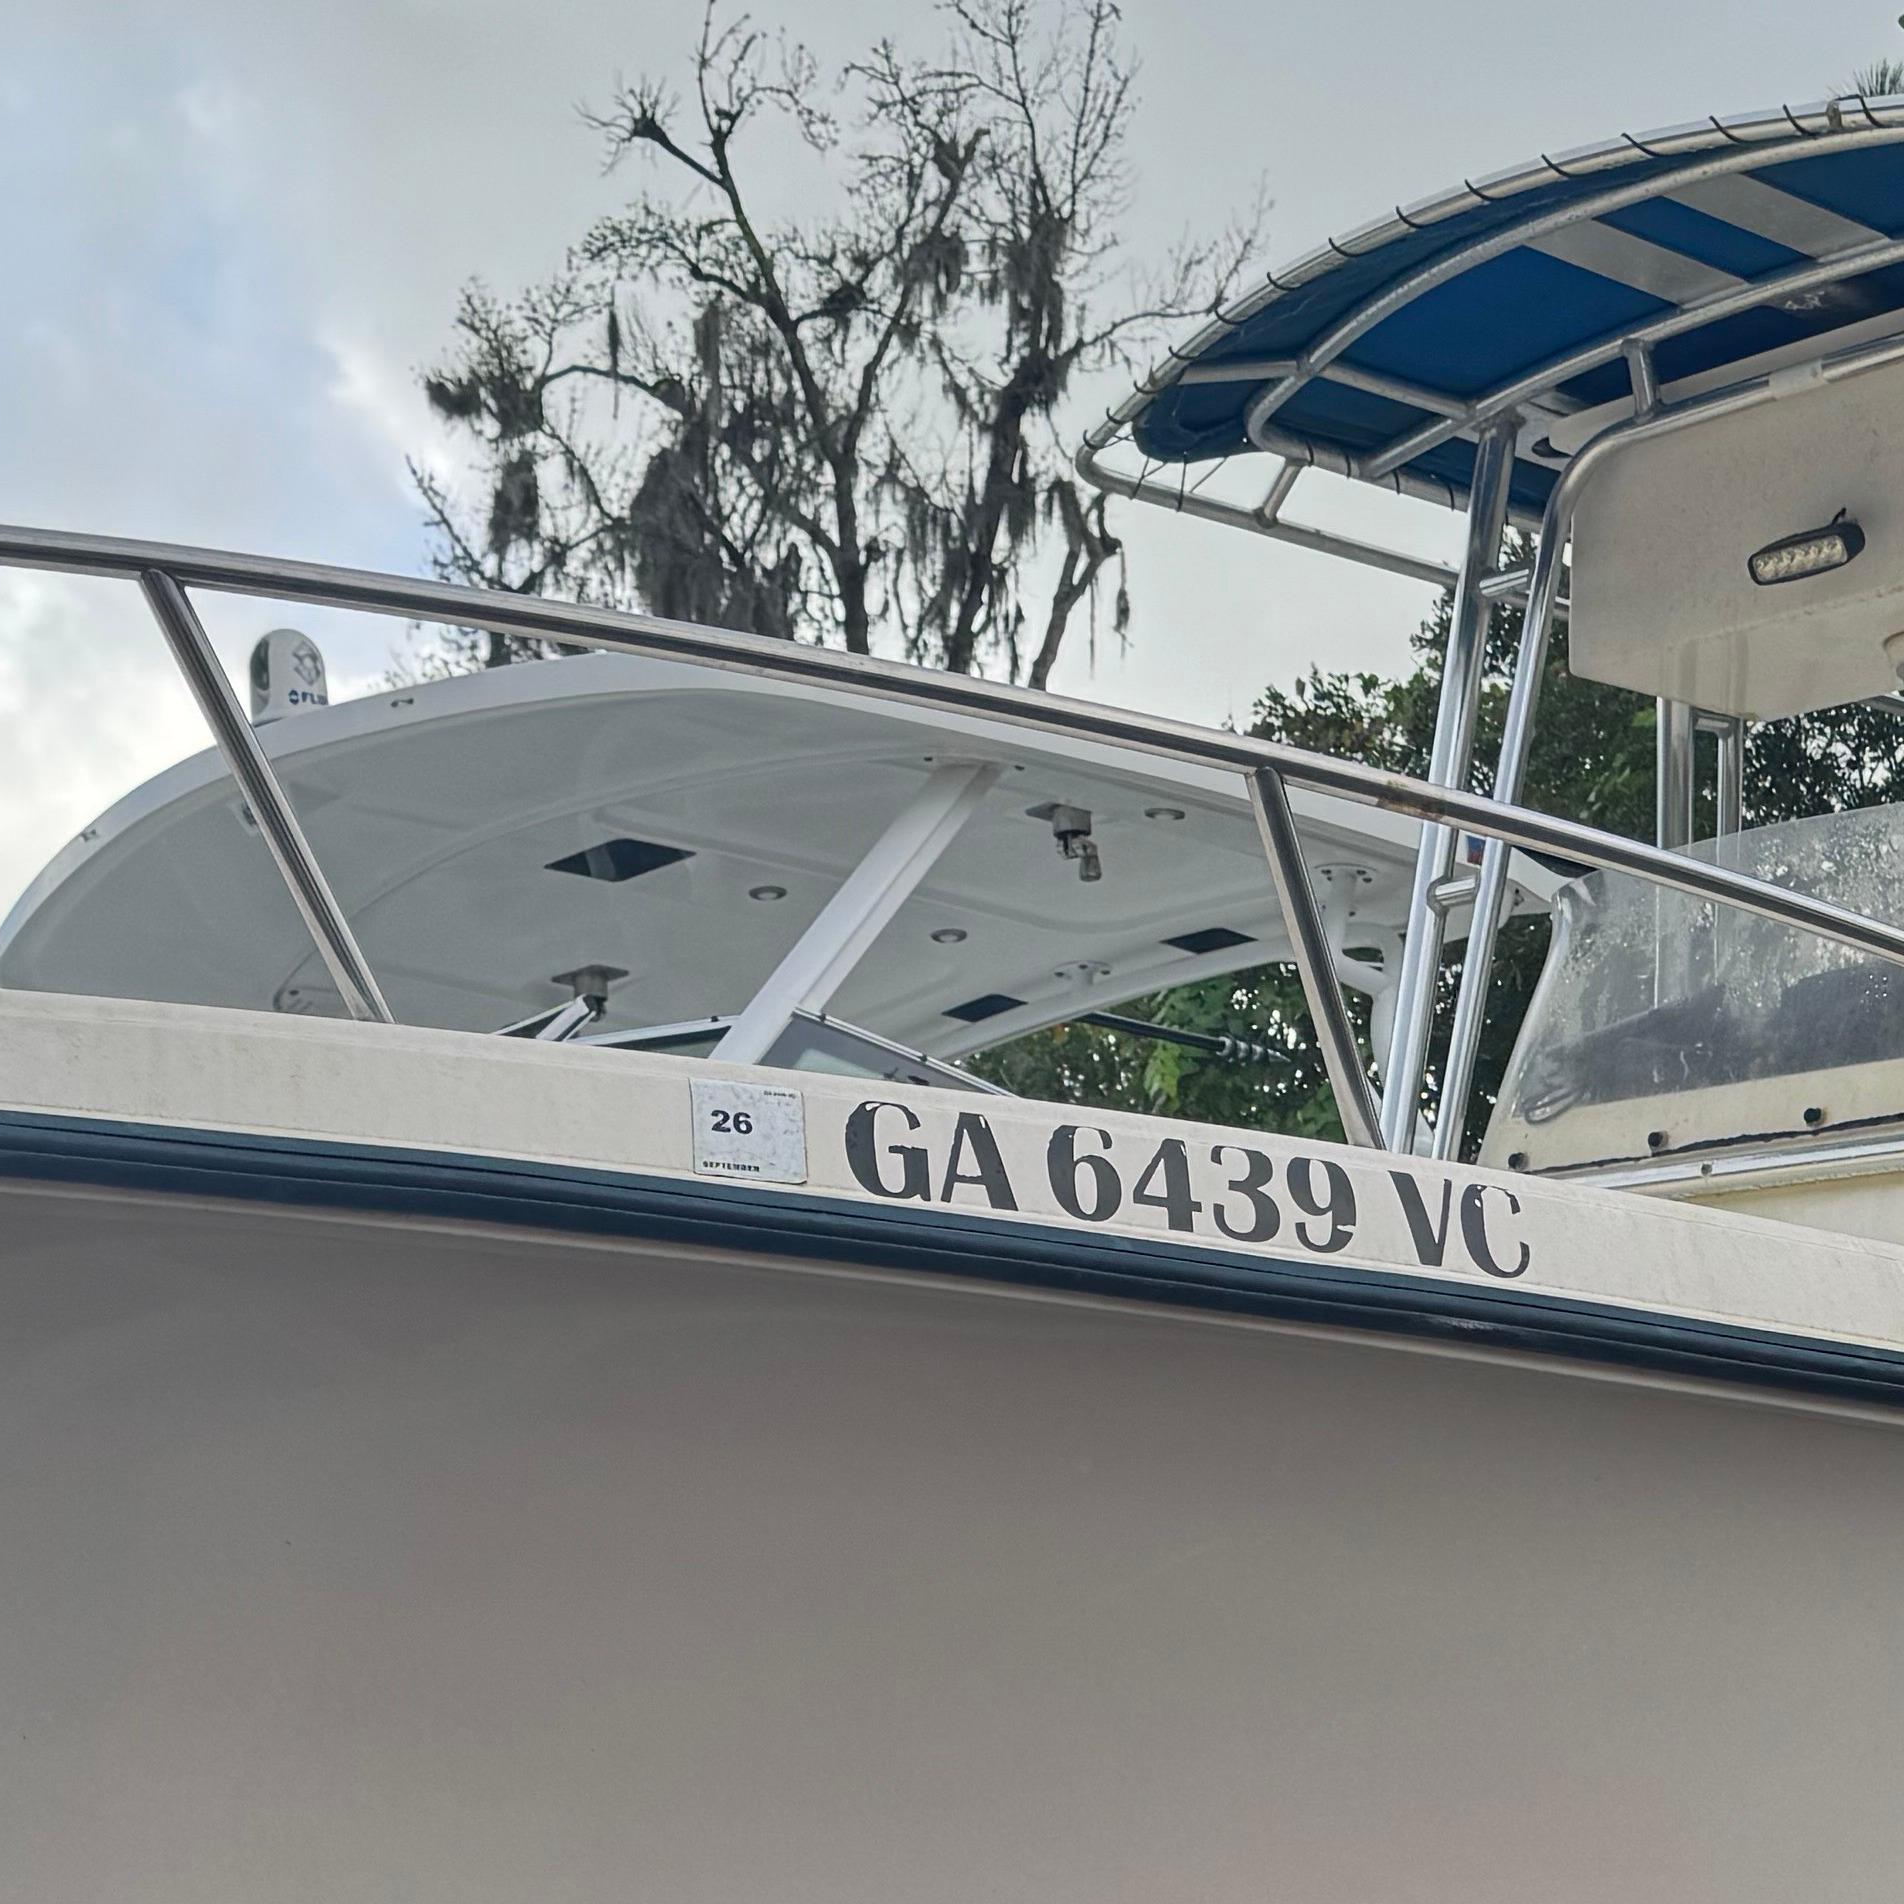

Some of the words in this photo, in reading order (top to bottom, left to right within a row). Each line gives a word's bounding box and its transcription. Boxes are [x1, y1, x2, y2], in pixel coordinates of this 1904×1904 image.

[710, 1109, 753, 1135] 26
[845, 1100, 1018, 1212] GA
[1046, 1124, 1357, 1254] 6439
[1389, 1169, 1530, 1279] VC
